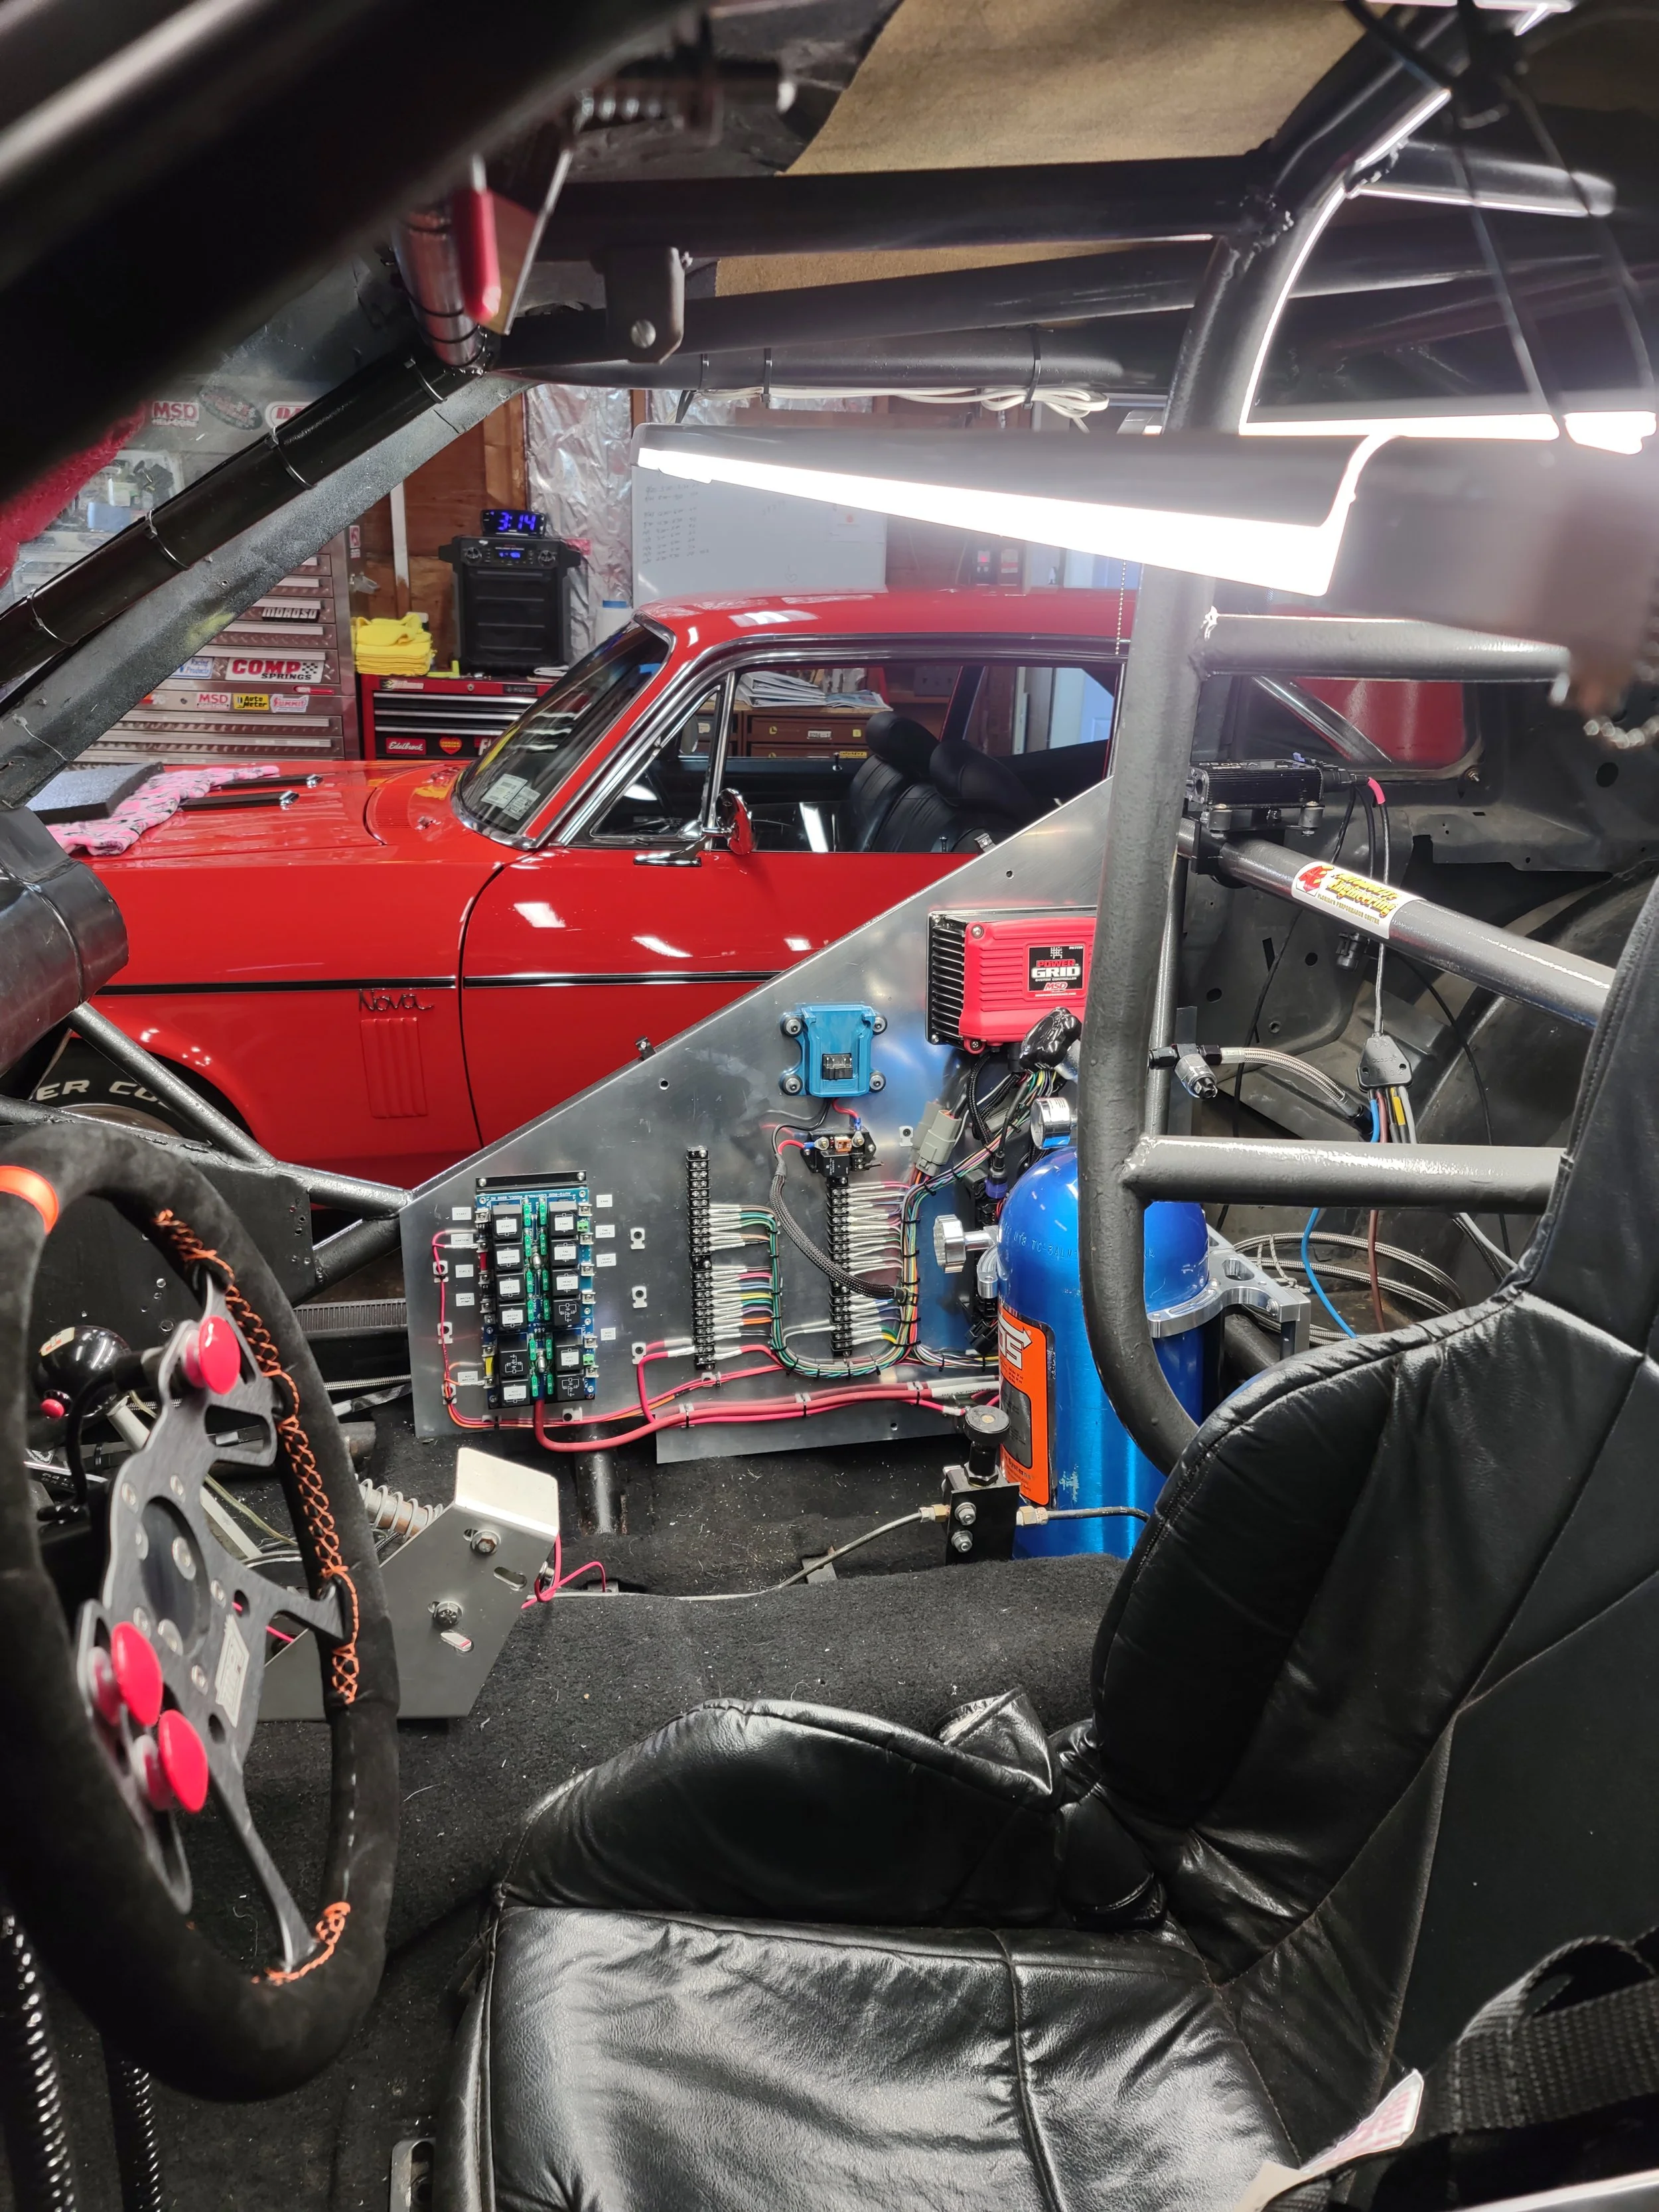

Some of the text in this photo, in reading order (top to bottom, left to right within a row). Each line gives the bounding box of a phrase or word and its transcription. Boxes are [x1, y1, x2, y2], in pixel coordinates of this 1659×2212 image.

[153, 402, 198, 419] MSD
[497, 512, 536, 530] 3:14
[262, 607, 317, 619] MOROSO
[232, 659, 301, 675] COMP
[199, 695, 228, 704] MSD
[273, 698, 307, 707] Summit
[389, 741, 423, 751] Edelbrock
[1325, 880, 1396, 919] Engineering
[1037, 959, 1075, 968] POWER
[1031, 966, 1081, 979] GRID
[1043, 982, 1068, 992] MSD
[358, 988, 435, 1012] Nova
[36, 1080, 165, 1107] ER CO
